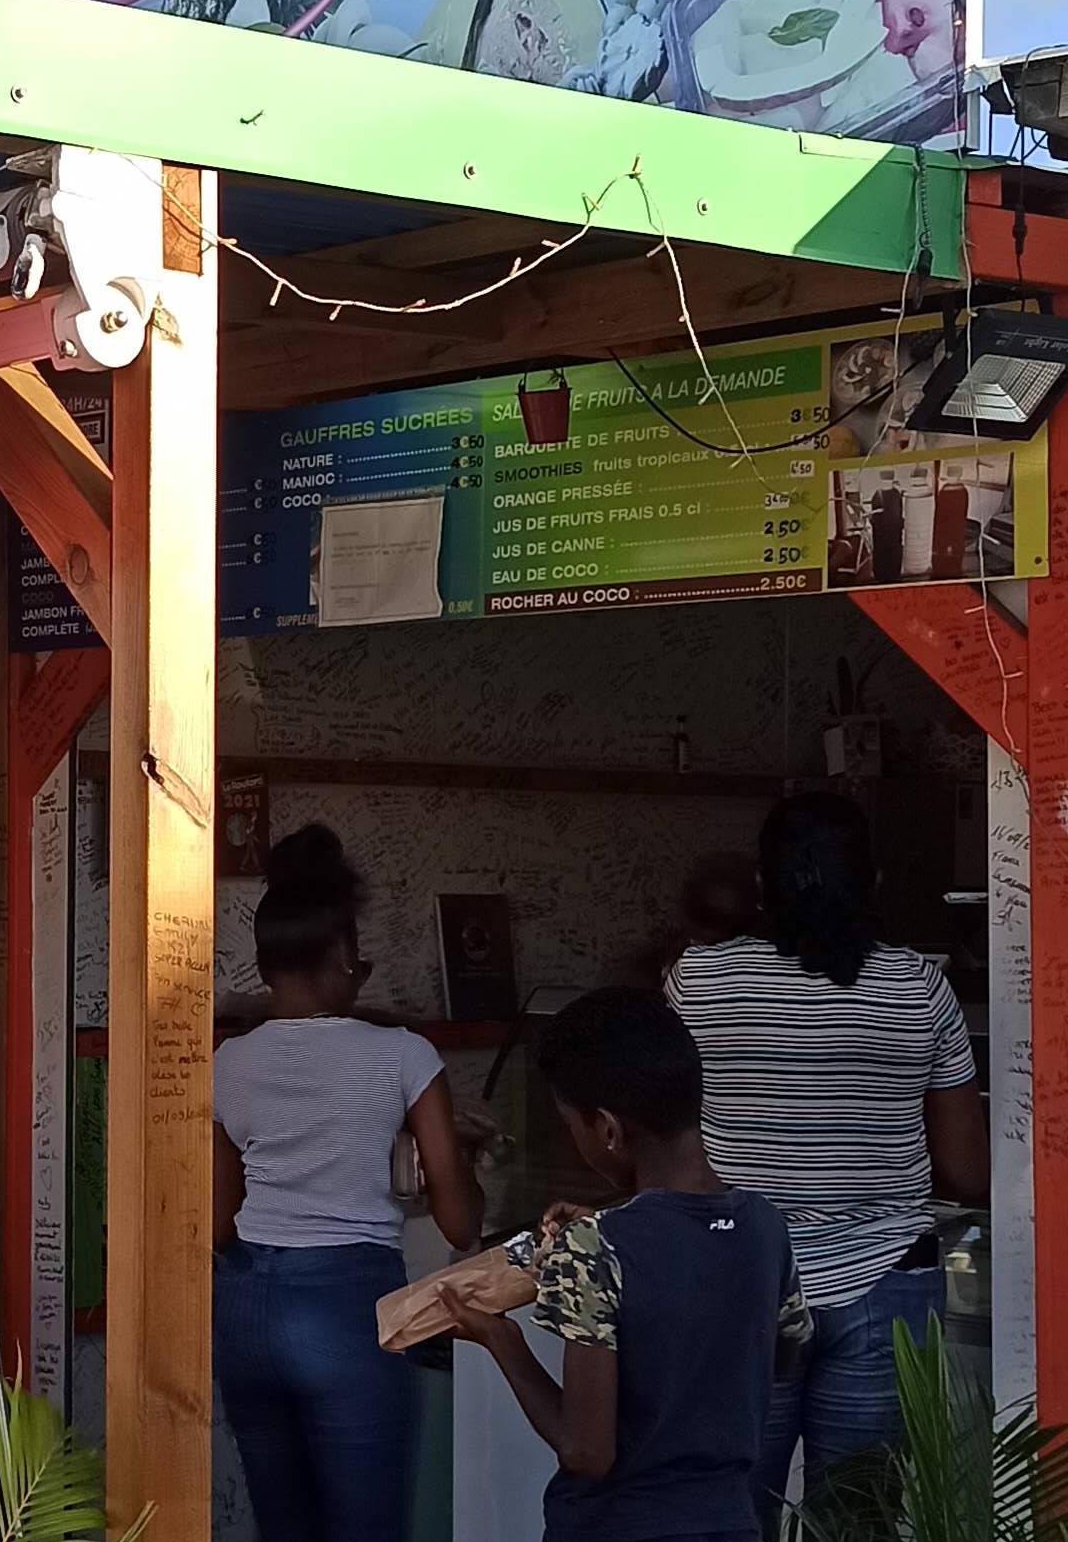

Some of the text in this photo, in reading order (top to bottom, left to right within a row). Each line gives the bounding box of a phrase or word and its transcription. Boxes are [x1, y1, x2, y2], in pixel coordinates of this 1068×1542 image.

[587, 384, 649, 411] FRUITS
[650, 383, 664, 401] A
[667, 379, 690, 399] LA
[694, 365, 787, 395] DEMANDE
[280, 406, 474, 449] GAUFFRES SUCRÉES
[587, 431, 611, 447] DE
[614, 424, 671, 445] FRUITS
[282, 452, 334, 472] NATURE
[494, 461, 583, 484] SMOOTHIES
[593, 456, 632, 473] fruits
[636, 447, 709, 469] tropicaux
[282, 472, 336, 491] MANIOC
[281, 492, 322, 509] COCO
[493, 489, 557, 510] ORANGE
[561, 479, 634, 502] PRESSÉE
[492, 519, 522, 536] JUS
[526, 516, 548, 532] DE
[550, 509, 605, 530] FRUITS
[608, 504, 654, 524] FRAIS
[659, 502, 684, 519] 0.5
[686, 501, 701, 516] cl
[492, 543, 522, 560] JUS
[526, 541, 548, 557] DE
[550, 535, 605, 555] CANNE
[21, 572, 67, 587] COMPL
[491, 568, 522, 586] EAU
[526, 566, 548, 582] DE
[551, 561, 599, 580] COCO
[491, 574, 807, 611] ROCHER AU COCO 2.50€
[21, 607, 69, 622] JAMBON
[222, 793, 261, 810] 2021
[708, 1218, 736, 1231] FILA
